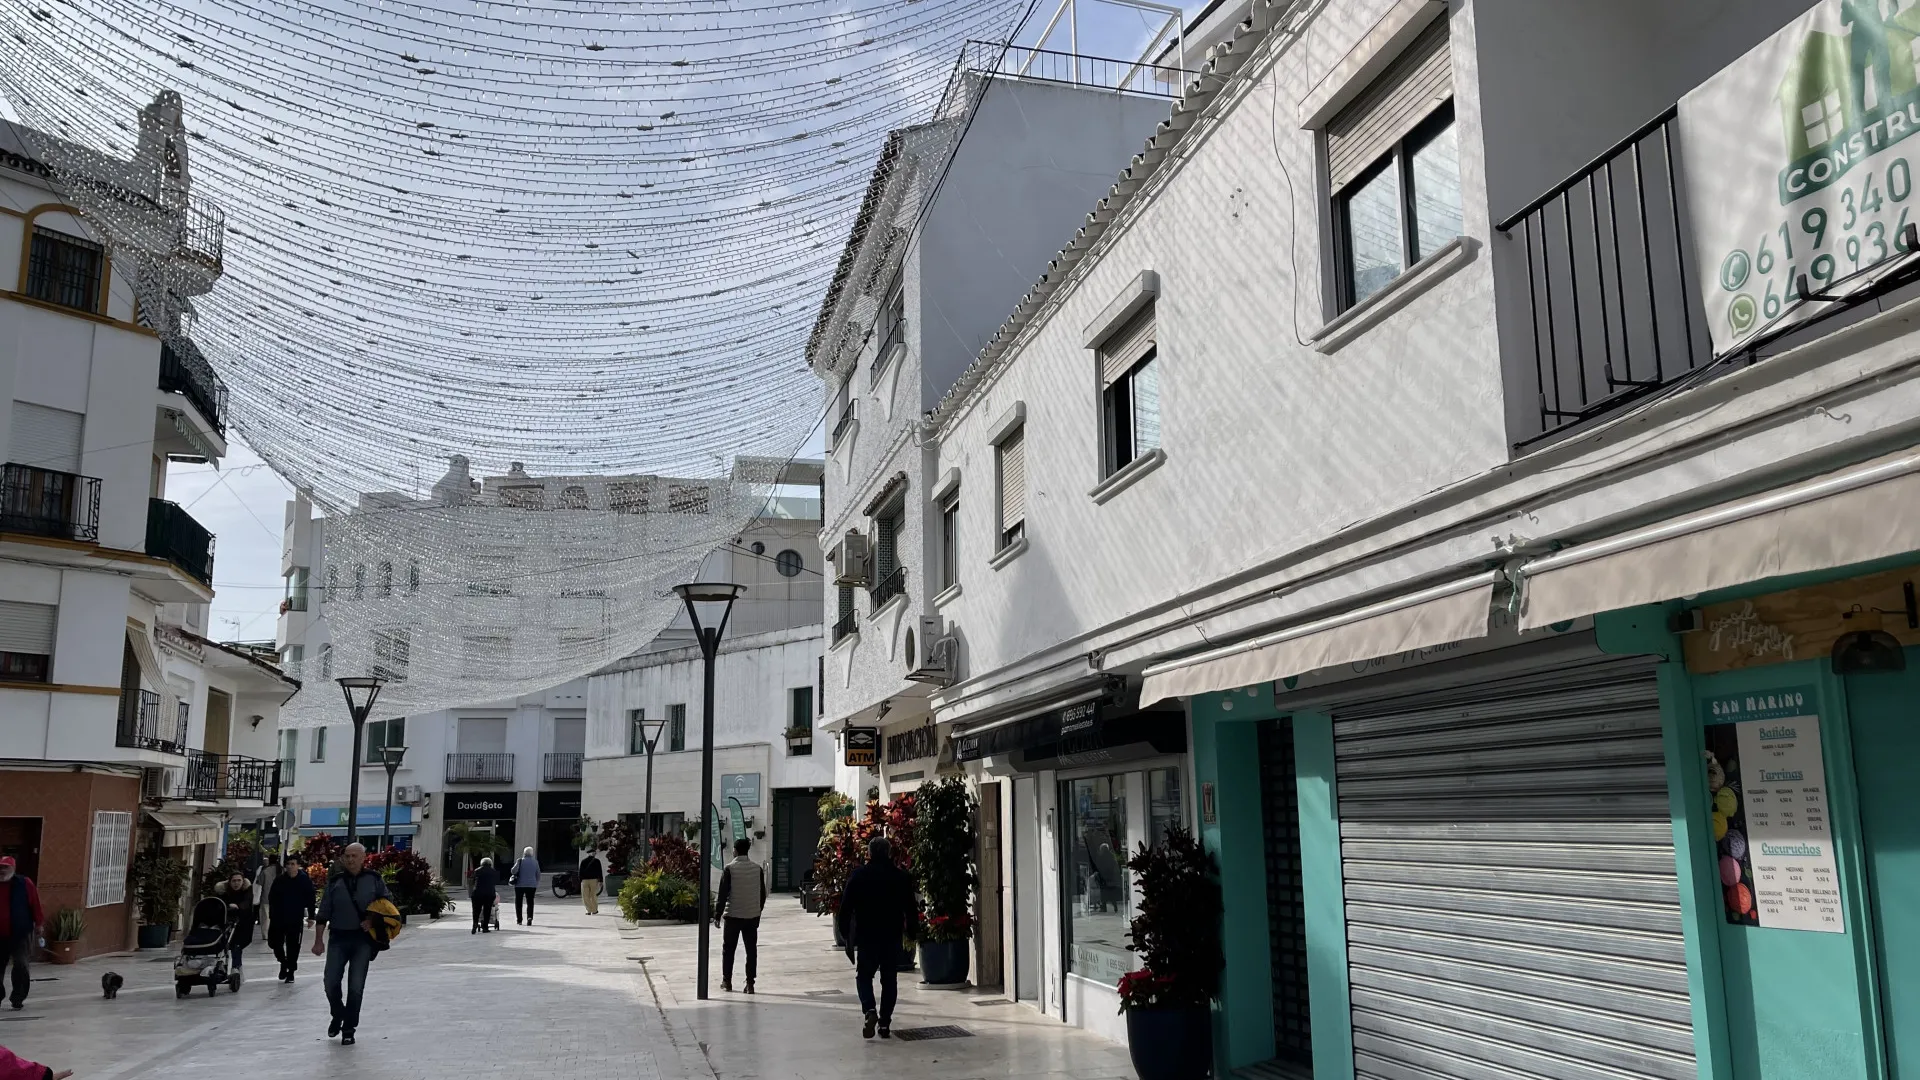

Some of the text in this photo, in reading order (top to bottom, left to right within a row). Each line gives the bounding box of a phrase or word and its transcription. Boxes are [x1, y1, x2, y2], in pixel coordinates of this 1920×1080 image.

[1756, 157, 1912, 275] 619 340
[1762, 253, 1836, 320] 649
[1712, 700, 1740, 715] SAN
[1759, 727, 1797, 741] Batidos
[848, 752, 875, 764] ATM
[1759, 768, 1803, 782] Tarrinas
[1761, 842, 1821, 856] Cucuruchos
